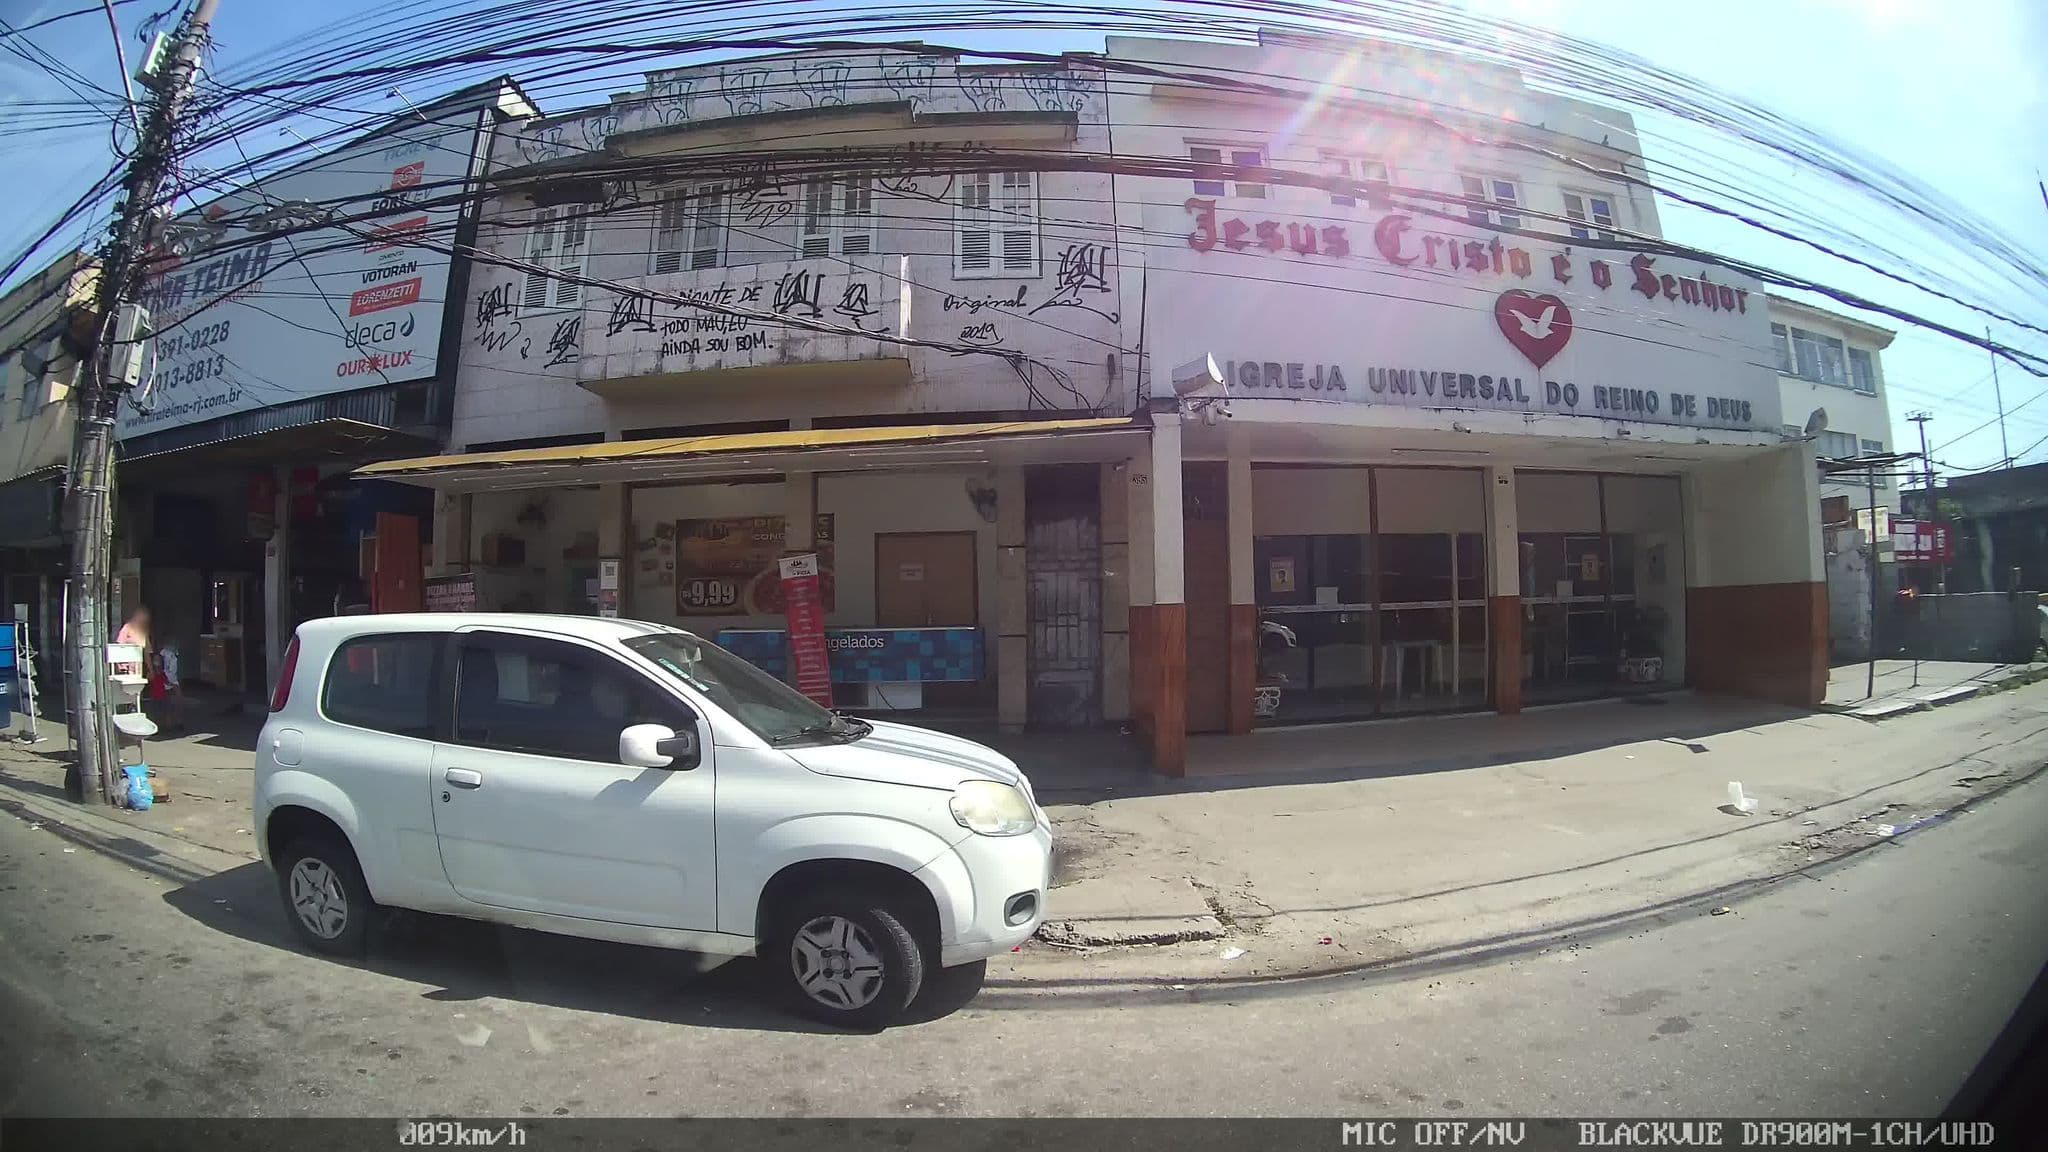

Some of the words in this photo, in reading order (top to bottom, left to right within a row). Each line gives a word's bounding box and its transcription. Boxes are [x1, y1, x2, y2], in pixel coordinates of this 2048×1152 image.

[1184, 198, 1350, 259] Jesus
[1375, 214, 1532, 280] Cristo
[1590, 259, 1613, 290] o
[1630, 252, 1749, 315] Senhor
[362, 260, 417, 284] VOTORAN
[356, 283, 414, 306] LORENZETTI
[737, 285, 763, 304] DE
[345, 321, 397, 349] deca
[705, 338, 729, 352] SOU
[1226, 360, 1348, 392] IGREJA
[1367, 366, 1530, 403] UNIVERSAL
[1545, 381, 1580, 408] DO
[1593, 385, 1660, 415] REINO
[1670, 393, 1697, 417] DE
[1706, 396, 1752, 422] DEUS
